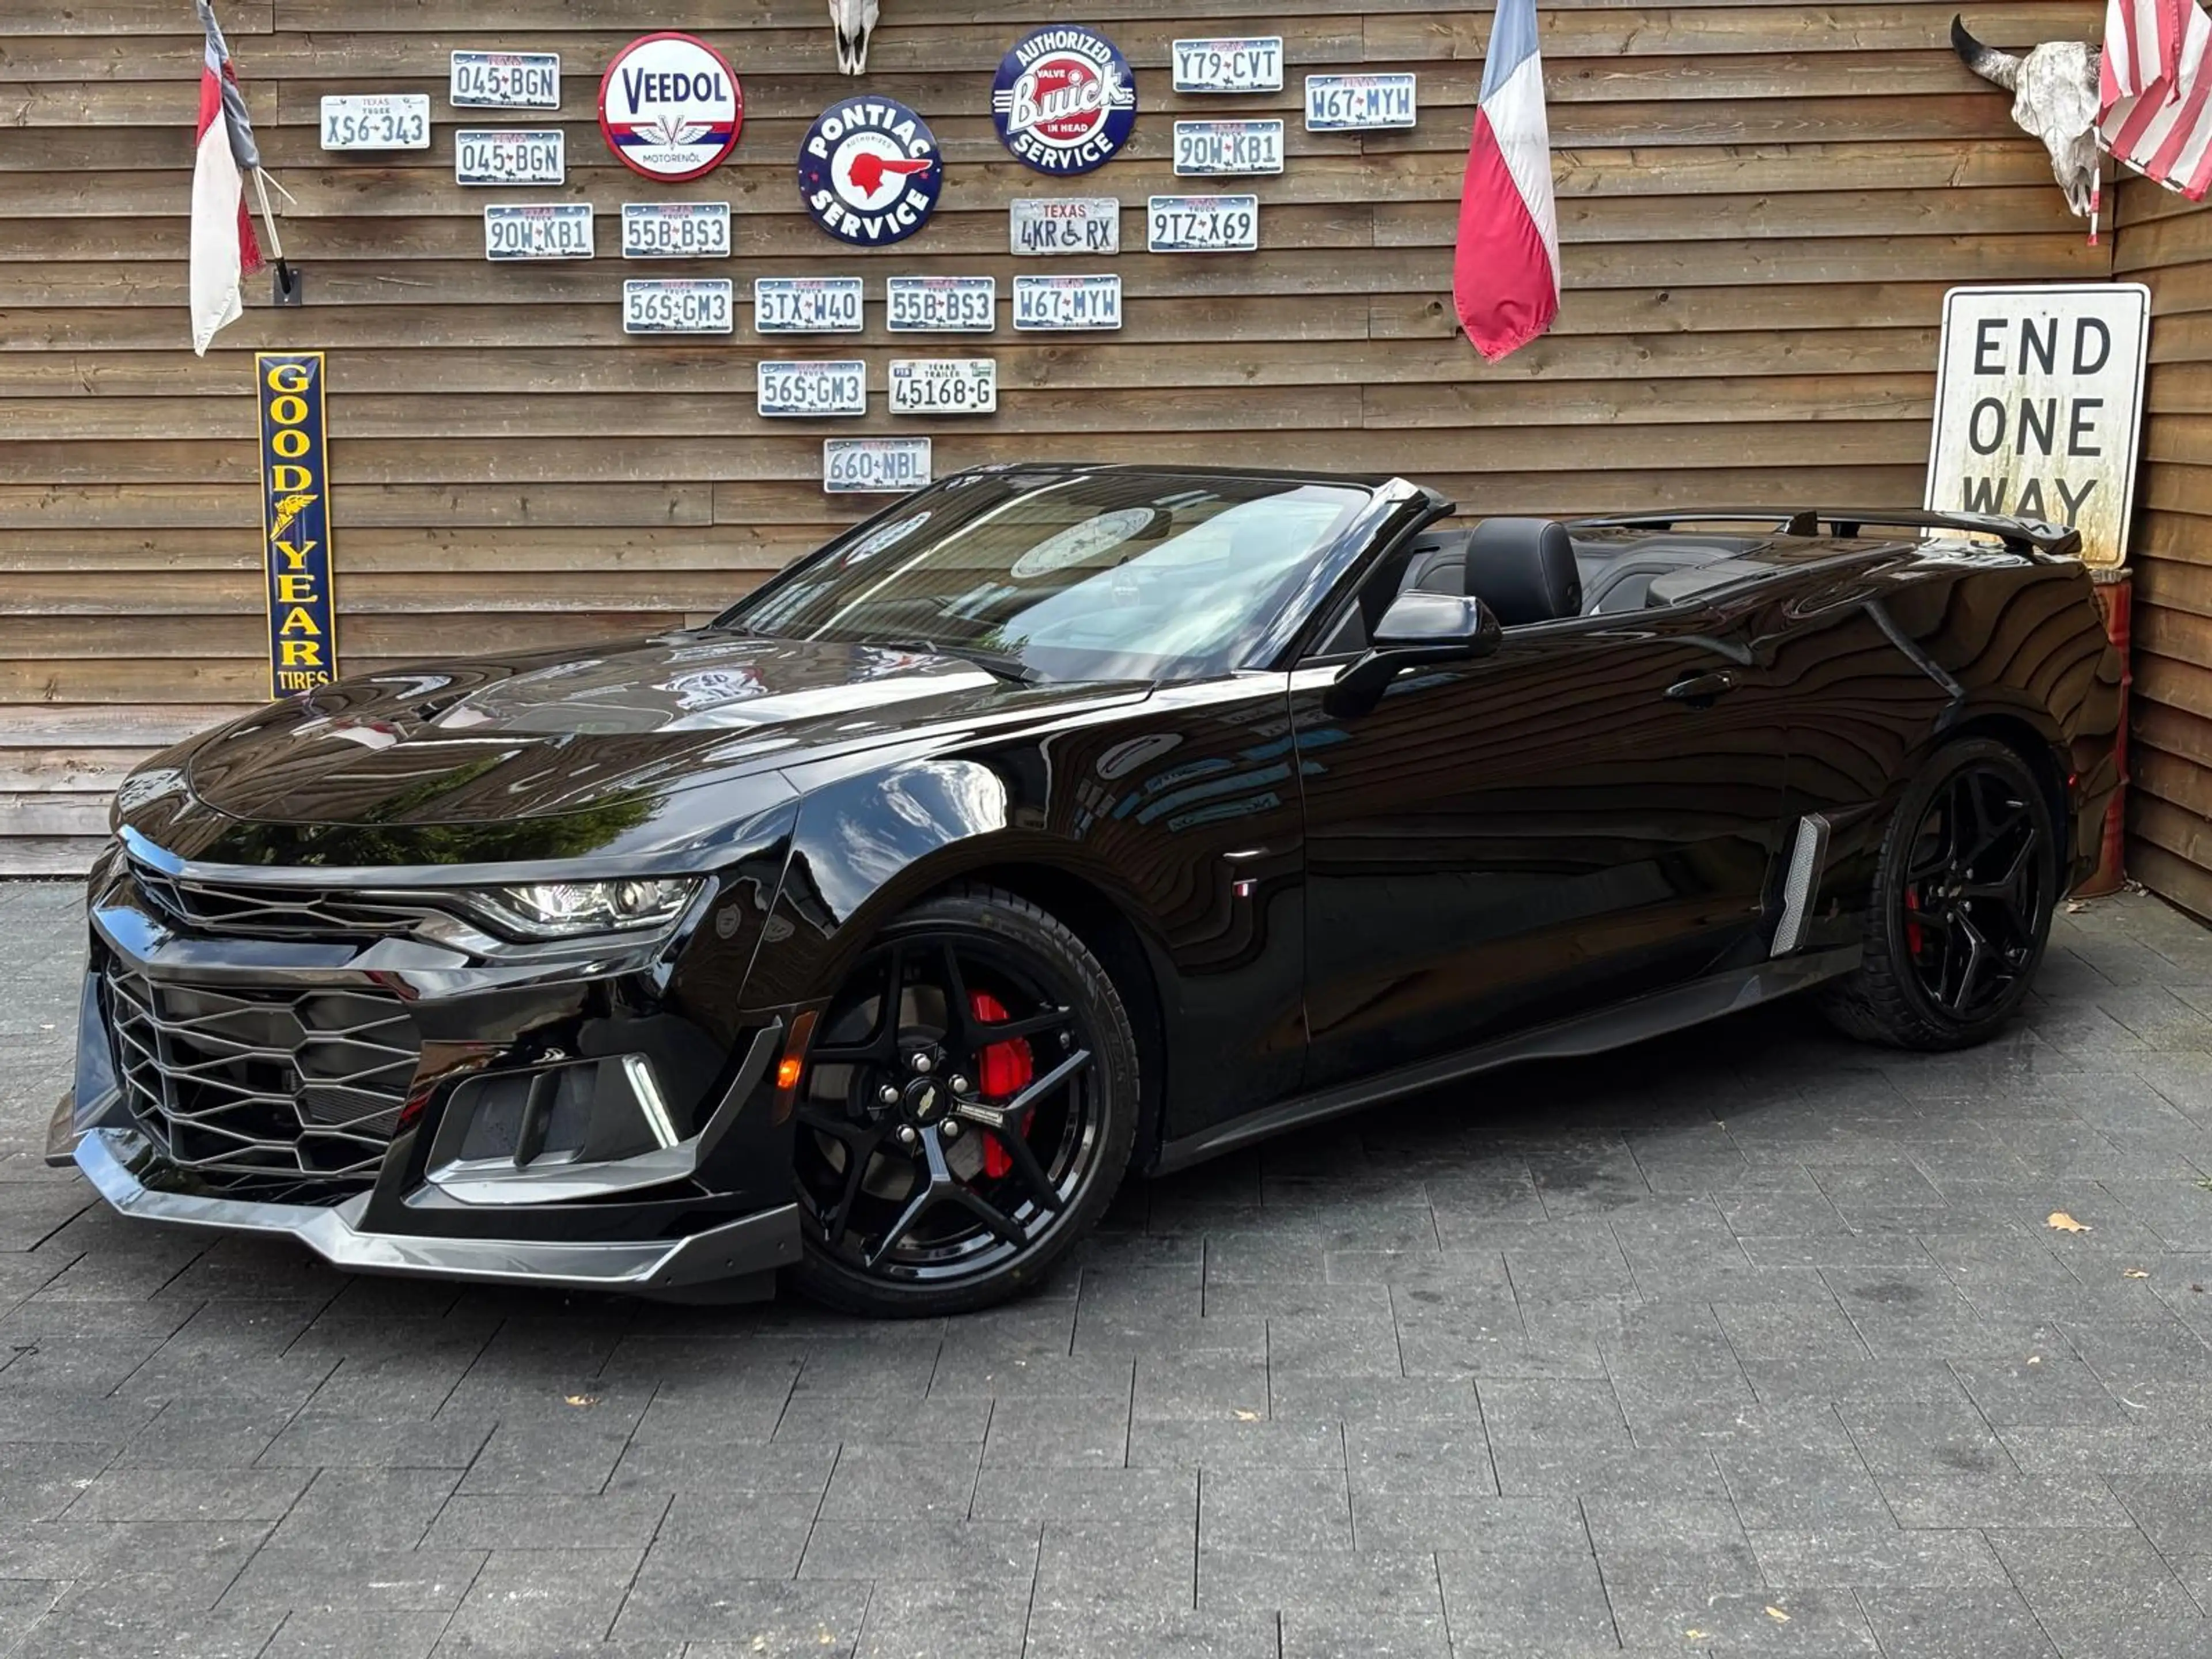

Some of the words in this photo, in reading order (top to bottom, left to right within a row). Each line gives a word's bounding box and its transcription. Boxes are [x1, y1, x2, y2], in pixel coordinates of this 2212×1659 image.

[1016, 31, 1111, 66] AUTHORIZED
[1037, 70, 1065, 78] VALVE
[1180, 52, 1221, 79] Y79
[1233, 51, 1275, 78] CVT
[457, 66, 501, 94] 045
[511, 68, 553, 96] BGN
[622, 67, 726, 114] VEEDOL
[1006, 61, 1129, 135] Buick
[1313, 89, 1355, 118] W67
[327, 116, 369, 143] XS6
[381, 115, 423, 142] 343
[808, 104, 931, 160] PONTIAC
[1048, 124, 1058, 132] IN
[1061, 124, 1088, 132] HEAD
[463, 145, 505, 172] 045
[516, 145, 558, 172] BGN
[1014, 132, 1113, 169] SERVICE
[1233, 135, 1276, 164] KB1
[810, 188, 930, 239] SERVICE
[1044, 204, 1086, 218] TEXAS
[544, 221, 586, 249] KB1
[628, 220, 671, 247] 55B
[682, 219, 724, 247] BS3
[1021, 221, 1056, 247] 4KR
[1087, 221, 1110, 247] RX
[1155, 214, 1196, 240] 9TZ
[1209, 213, 1251, 240] X69
[631, 294, 672, 320] 56S
[683, 294, 725, 321] GM3
[761, 294, 802, 320] 5TX
[815, 293, 855, 320] W40
[893, 293, 935, 320] 55B
[947, 293, 989, 320] BS3
[1020, 290, 1062, 317] W67
[1974, 317, 2111, 375] END
[764, 376, 806, 403] 56S
[817, 376, 859, 403] GM3
[896, 378, 965, 406] 45168
[978, 379, 990, 404] G
[1969, 397, 2104, 457] ONE
[831, 453, 873, 479] 660
[883, 453, 923, 479] NBL
[1963, 476, 2098, 527] WAY
[278, 671, 330, 690] TIRES
